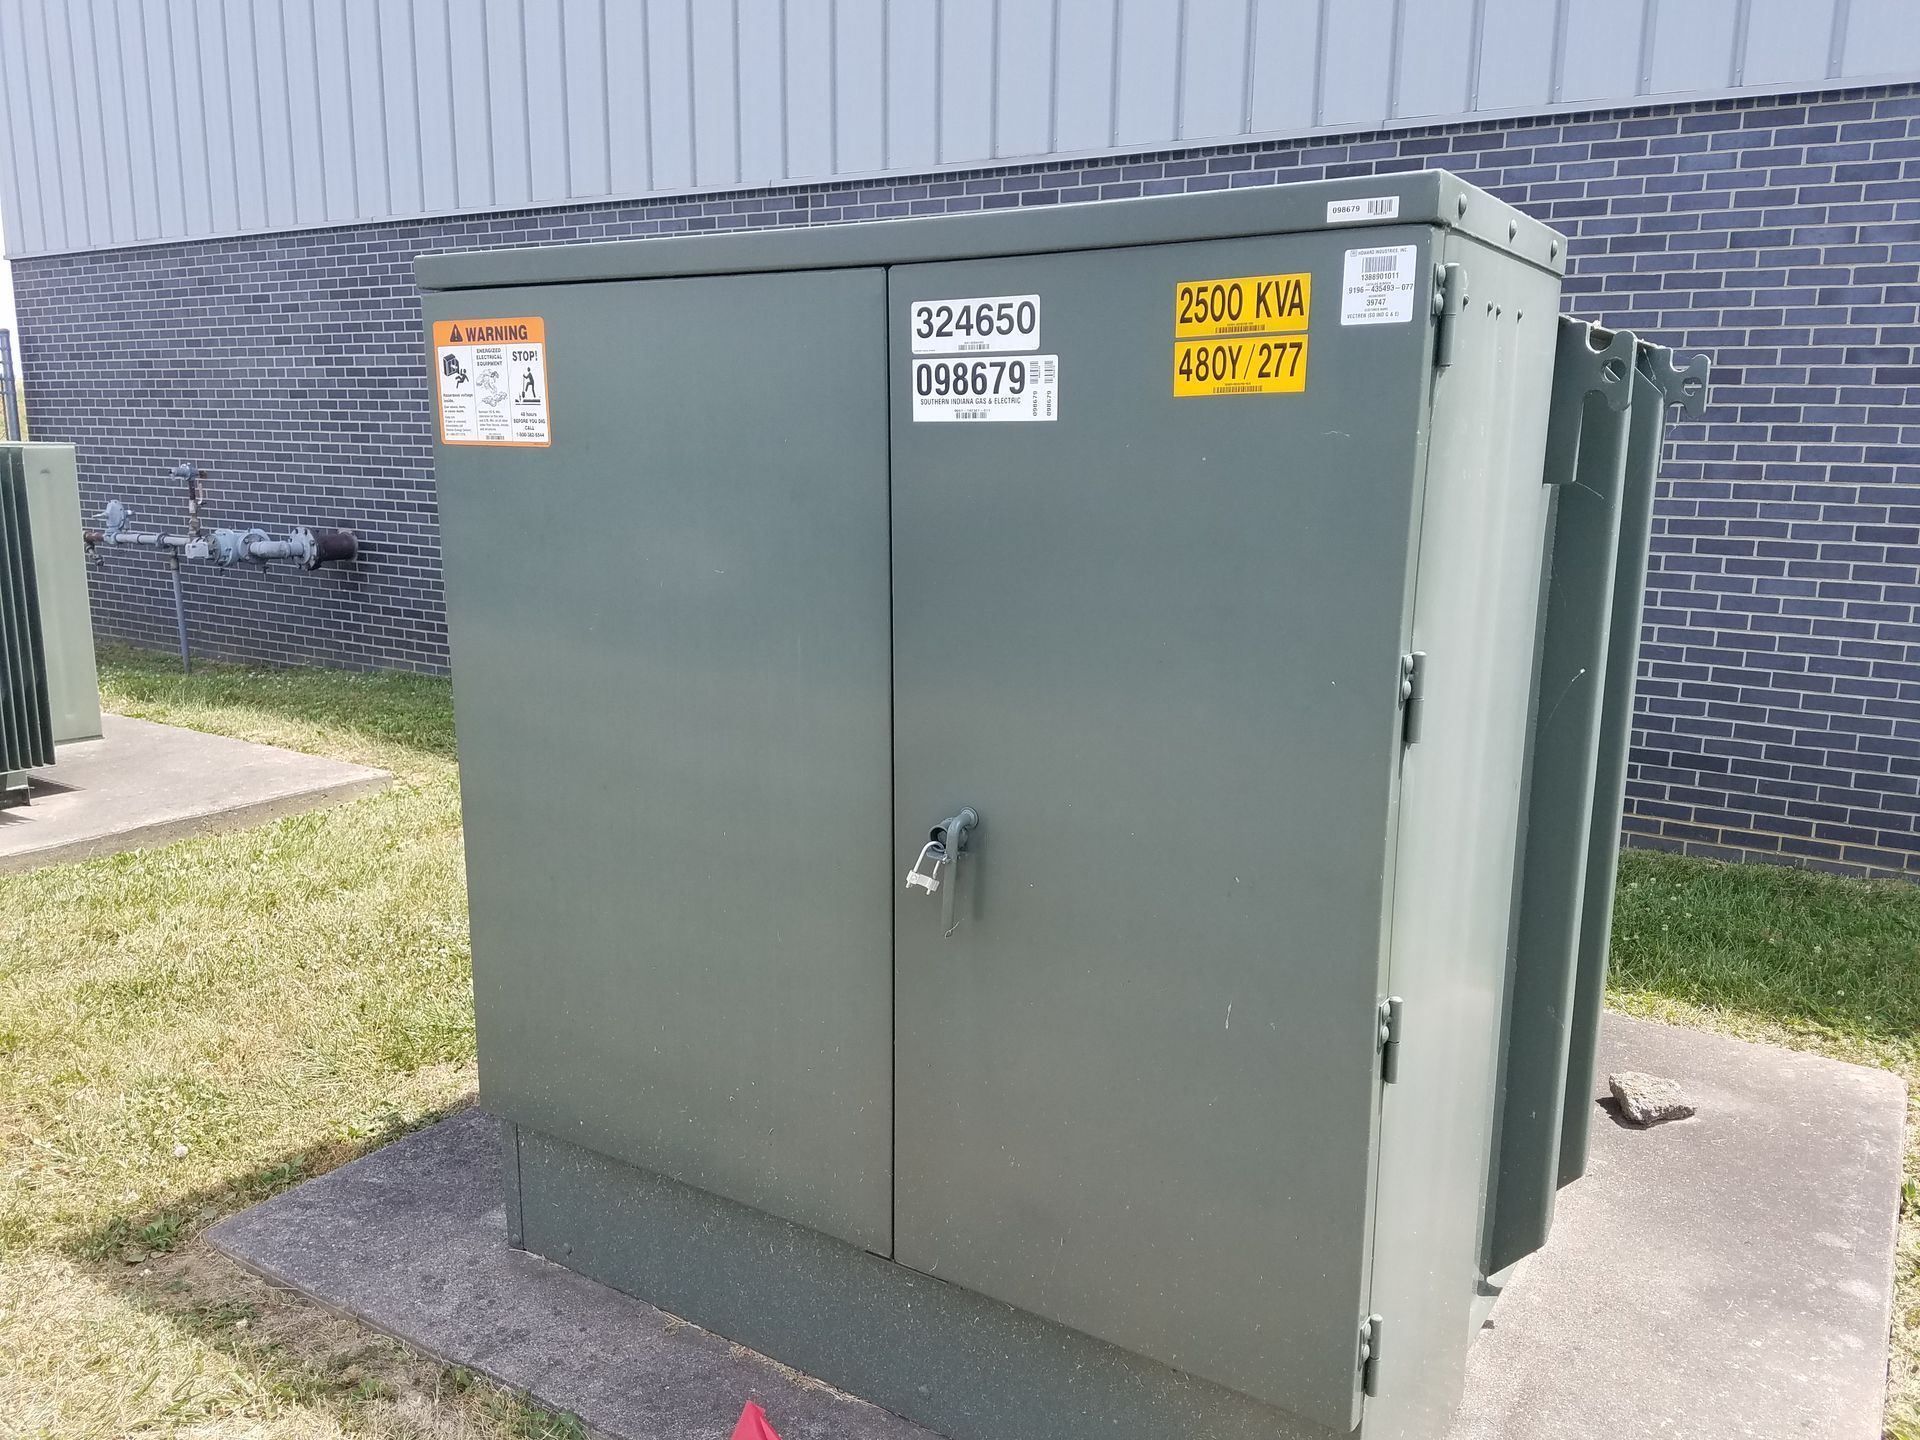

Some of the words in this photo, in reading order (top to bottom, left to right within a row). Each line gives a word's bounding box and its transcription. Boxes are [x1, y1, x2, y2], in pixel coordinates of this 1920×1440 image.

[1332, 205, 1361, 214] 098679
[1361, 272, 1399, 280] 1388901011
[1180, 283, 1243, 324] 2500
[1256, 279, 1304, 318] KVA
[1366, 298, 1386, 306] 39747
[916, 301, 1036, 338] 324650
[466, 324, 528, 342] WARNING
[512, 350, 538, 362] STOP!
[1179, 342, 1303, 382] 480Y/277
[916, 360, 1026, 396] 098679
